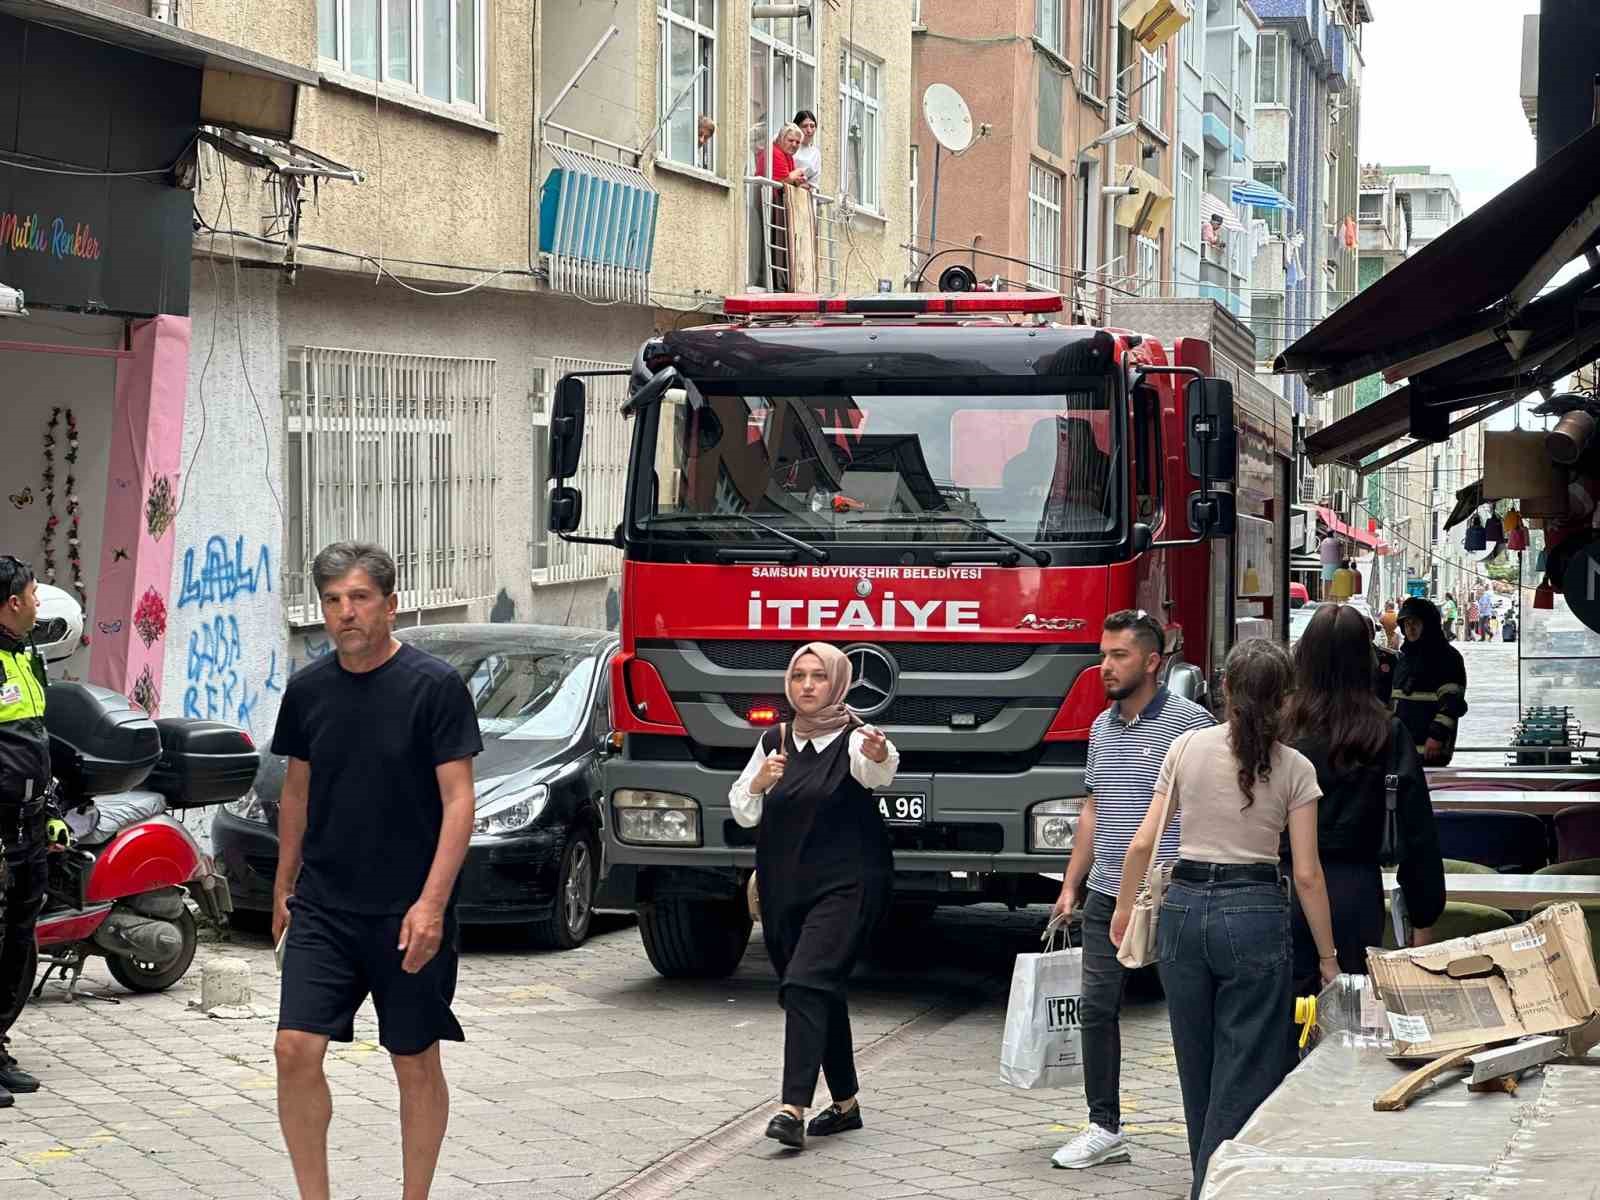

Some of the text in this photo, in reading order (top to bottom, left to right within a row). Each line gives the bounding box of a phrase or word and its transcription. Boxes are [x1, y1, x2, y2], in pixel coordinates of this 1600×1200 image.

[0, 212, 102, 260] Mutlu Renkler
[751, 567, 808, 577] SAMSUN
[903, 566, 982, 580] BELEDİYESİ
[748, 590, 981, 630] İTFAİYE
[895, 797, 923, 819] 96
